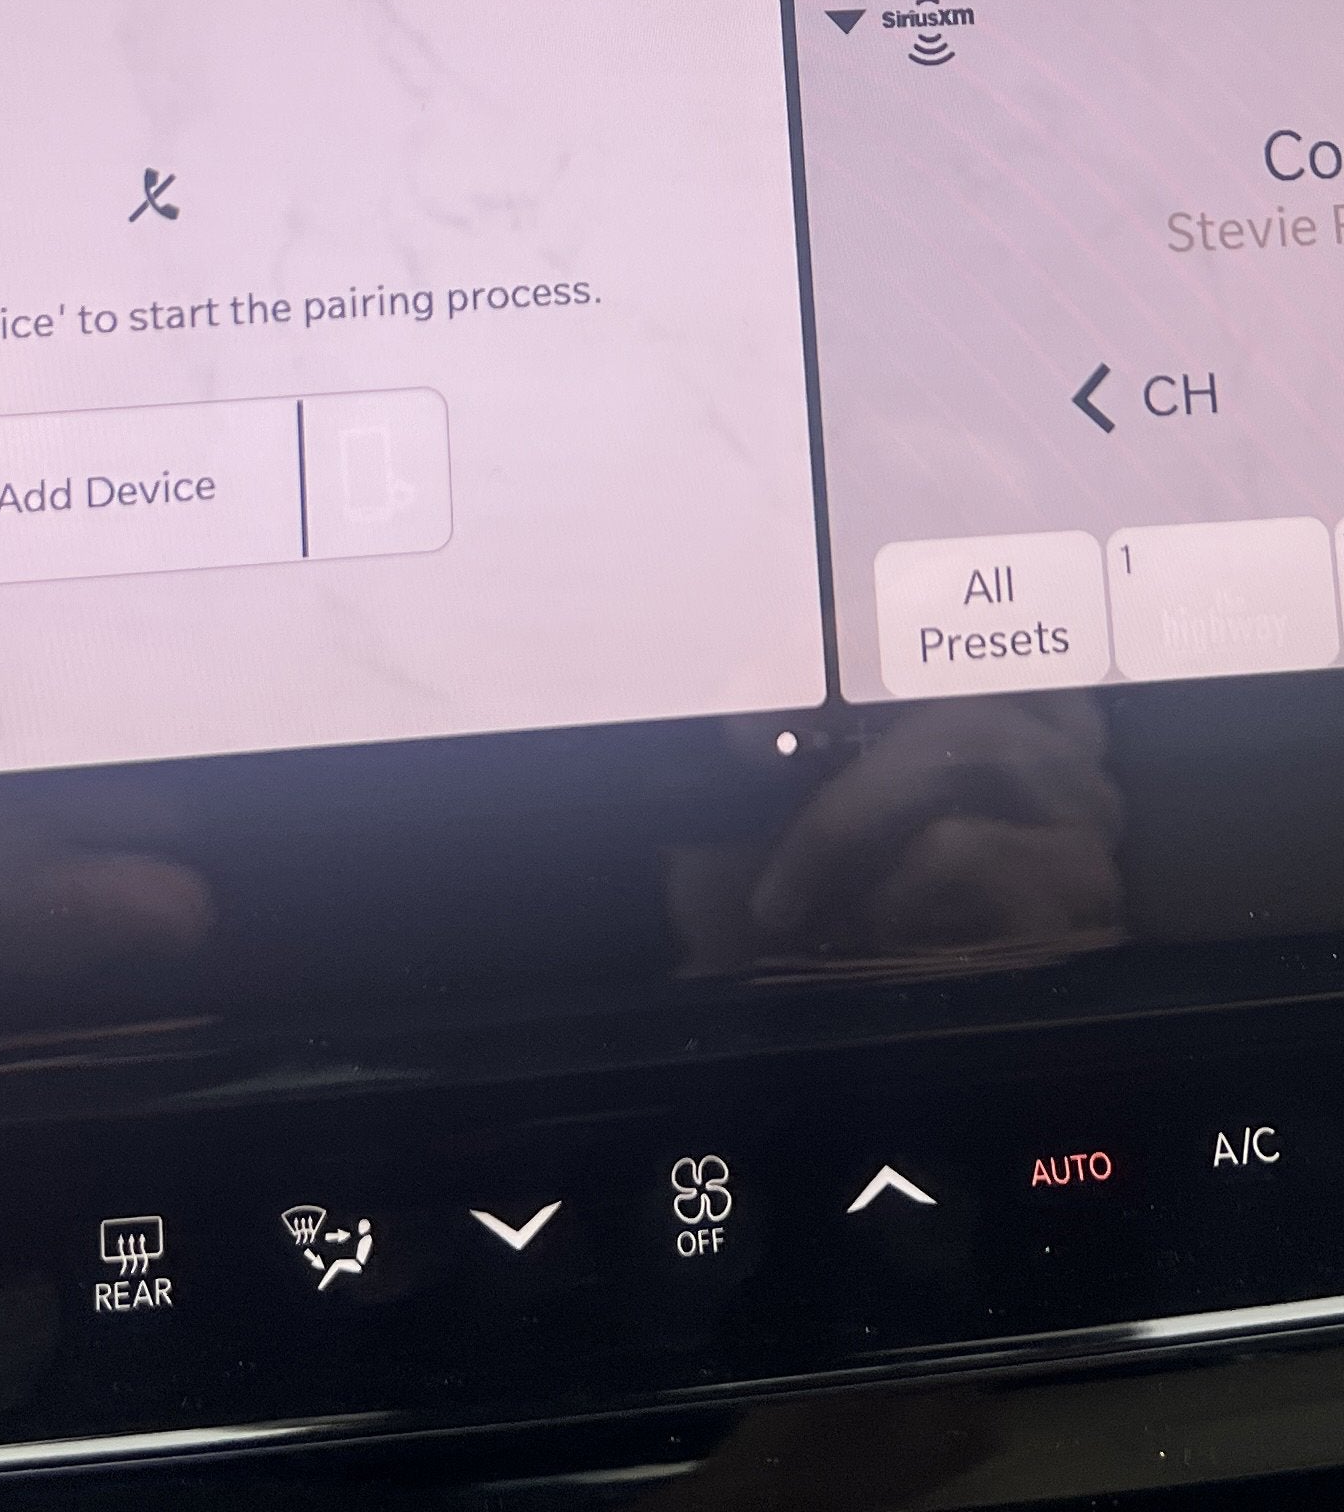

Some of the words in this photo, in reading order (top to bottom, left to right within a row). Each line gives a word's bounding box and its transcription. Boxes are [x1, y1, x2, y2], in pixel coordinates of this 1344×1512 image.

[1166, 202, 1318, 255] Stevie
[77, 304, 118, 335] to
[128, 296, 219, 332] start
[229, 292, 292, 325] the
[304, 284, 435, 329] pairing
[447, 281, 603, 320] process.
[1143, 372, 1220, 418] CH
[87, 469, 217, 511] Device
[1120, 544, 1133, 575] 1
[964, 566, 1016, 607] All
[918, 618, 1071, 665] Presets
[1214, 1126, 1281, 1169] A/C
[1031, 1150, 1113, 1188] AUTO
[676, 1229, 725, 1258] OFF
[94, 1277, 173, 1313] REAR
